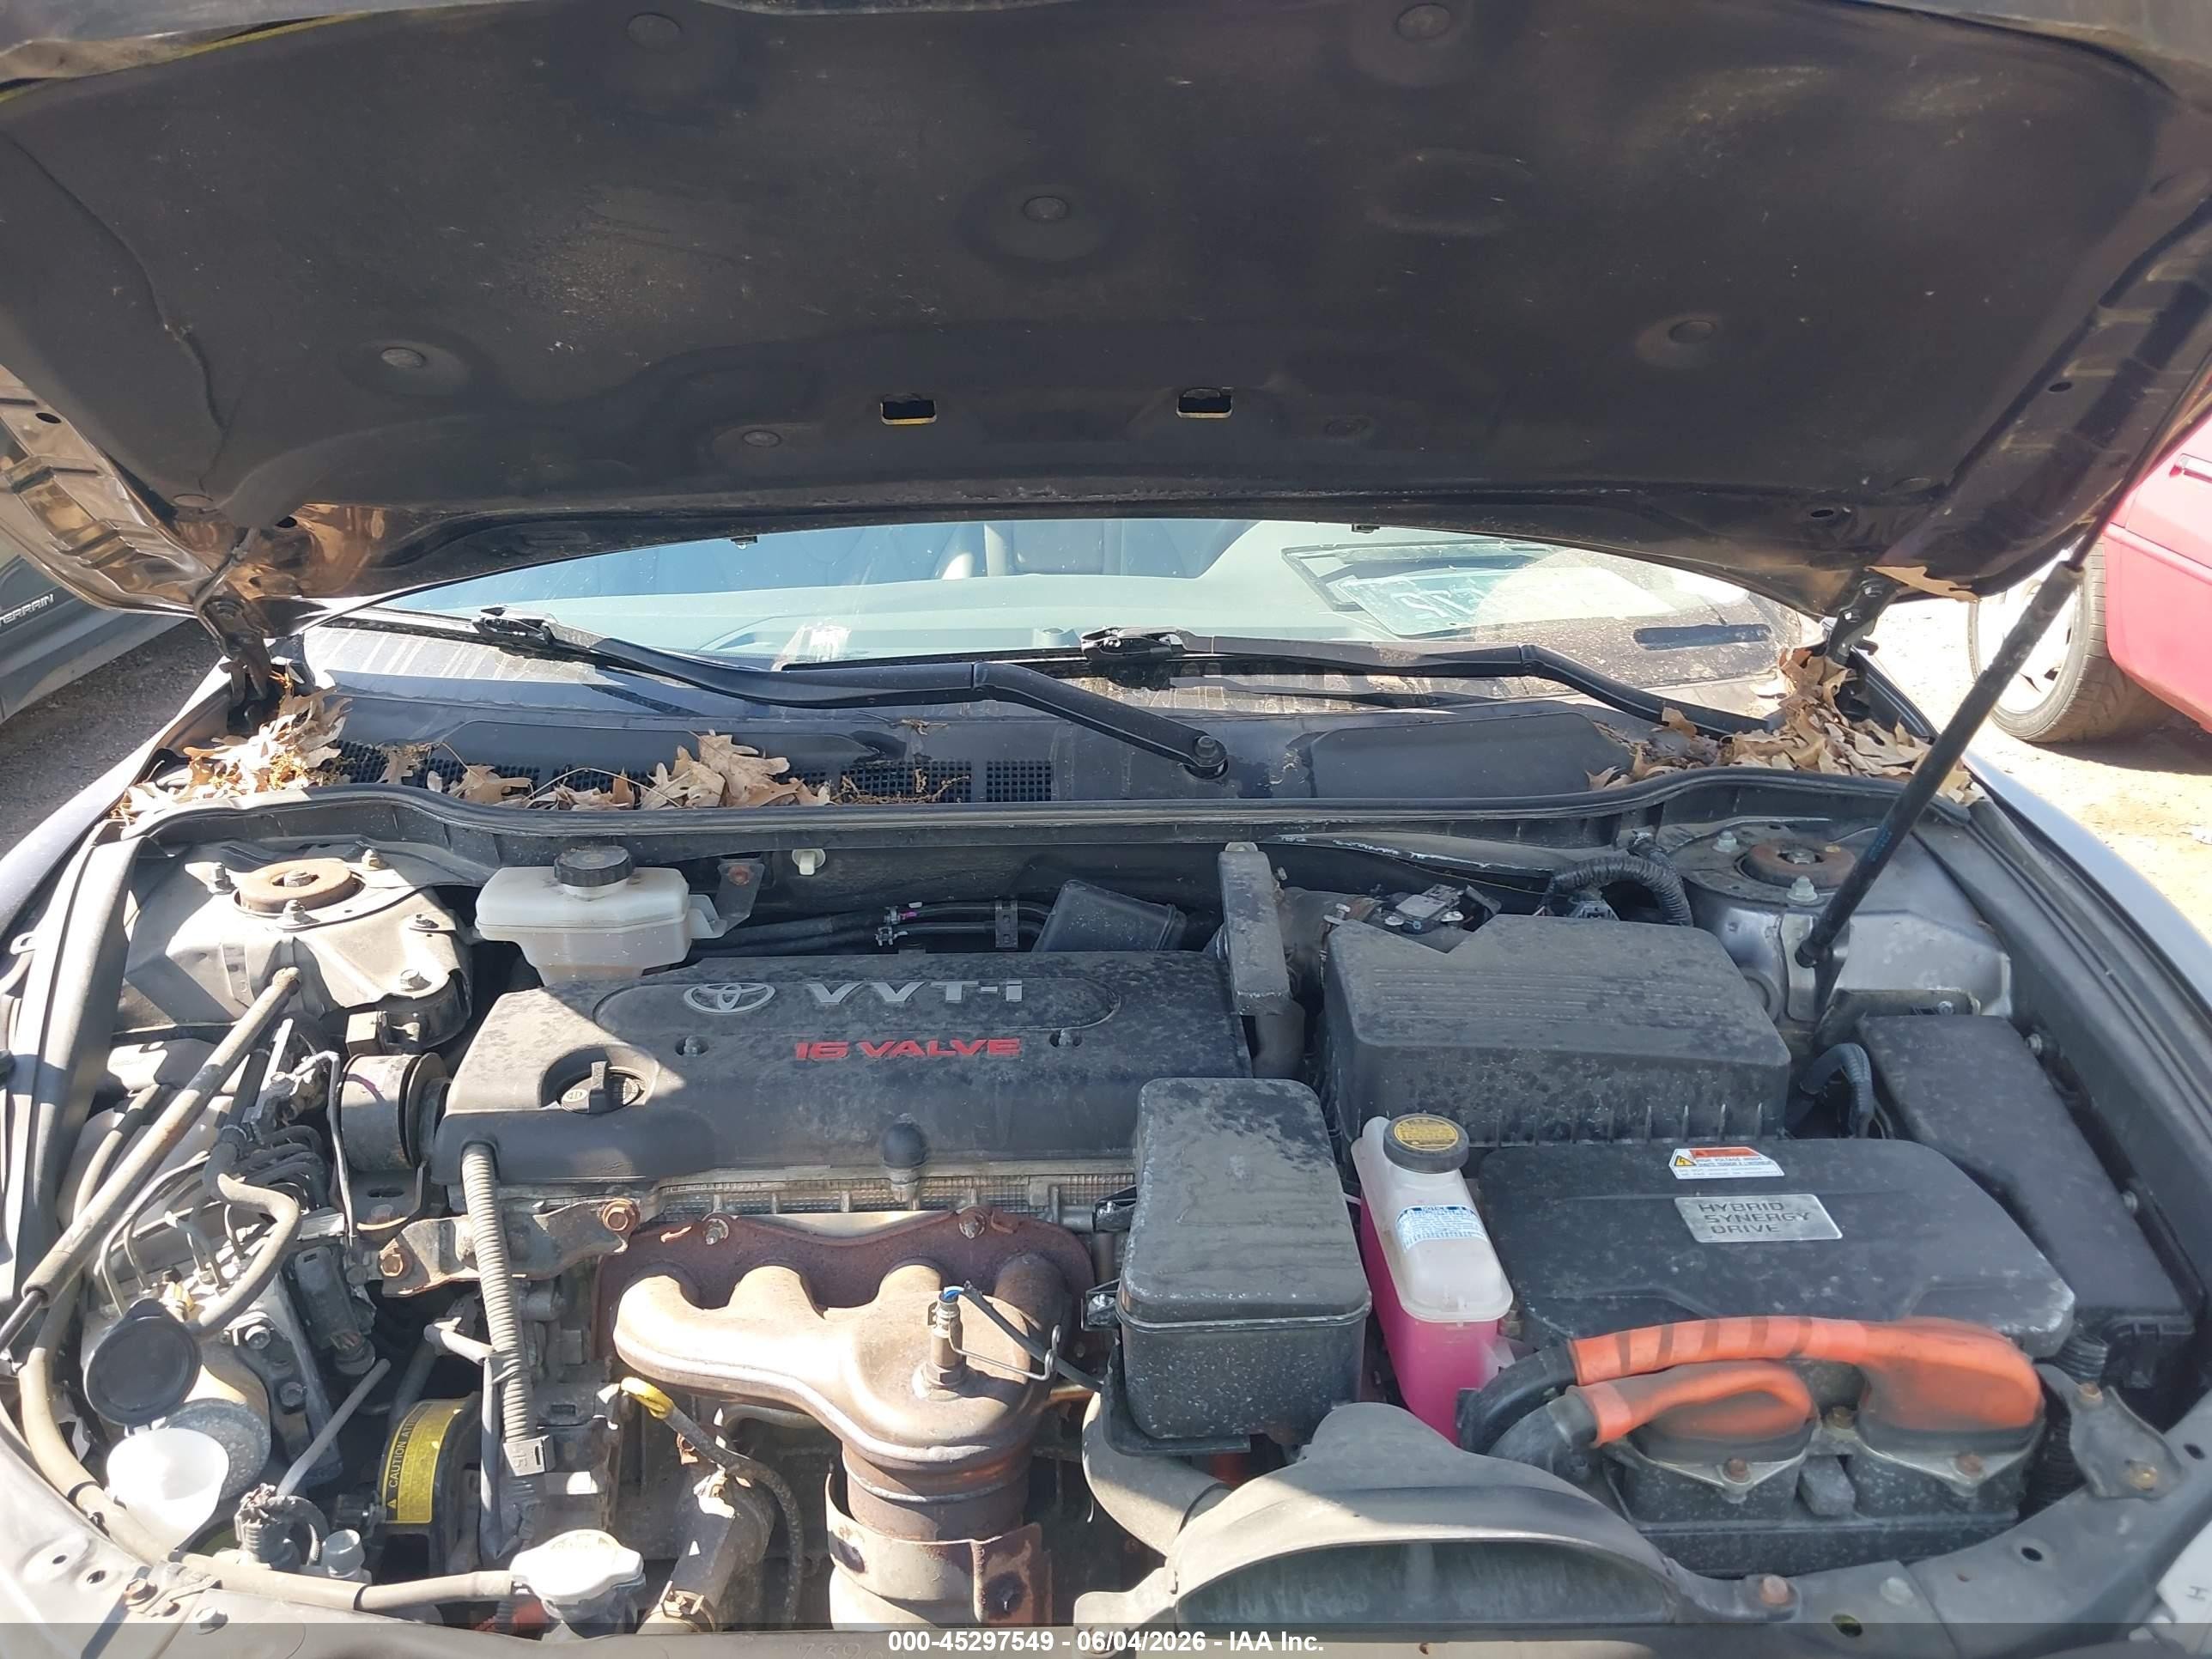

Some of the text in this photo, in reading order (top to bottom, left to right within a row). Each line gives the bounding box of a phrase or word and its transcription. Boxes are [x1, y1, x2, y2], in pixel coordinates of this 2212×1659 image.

[805, 980, 1023, 1003] VVT-i
[795, 1037, 1023, 1060] 16 VALVE
[1698, 1202, 1784, 1212] HYBRID
[1704, 1212, 1811, 1223] SYNERGY
[1710, 1224, 1780, 1234] DRIVE
[388, 1441, 407, 1488] CAUTION
